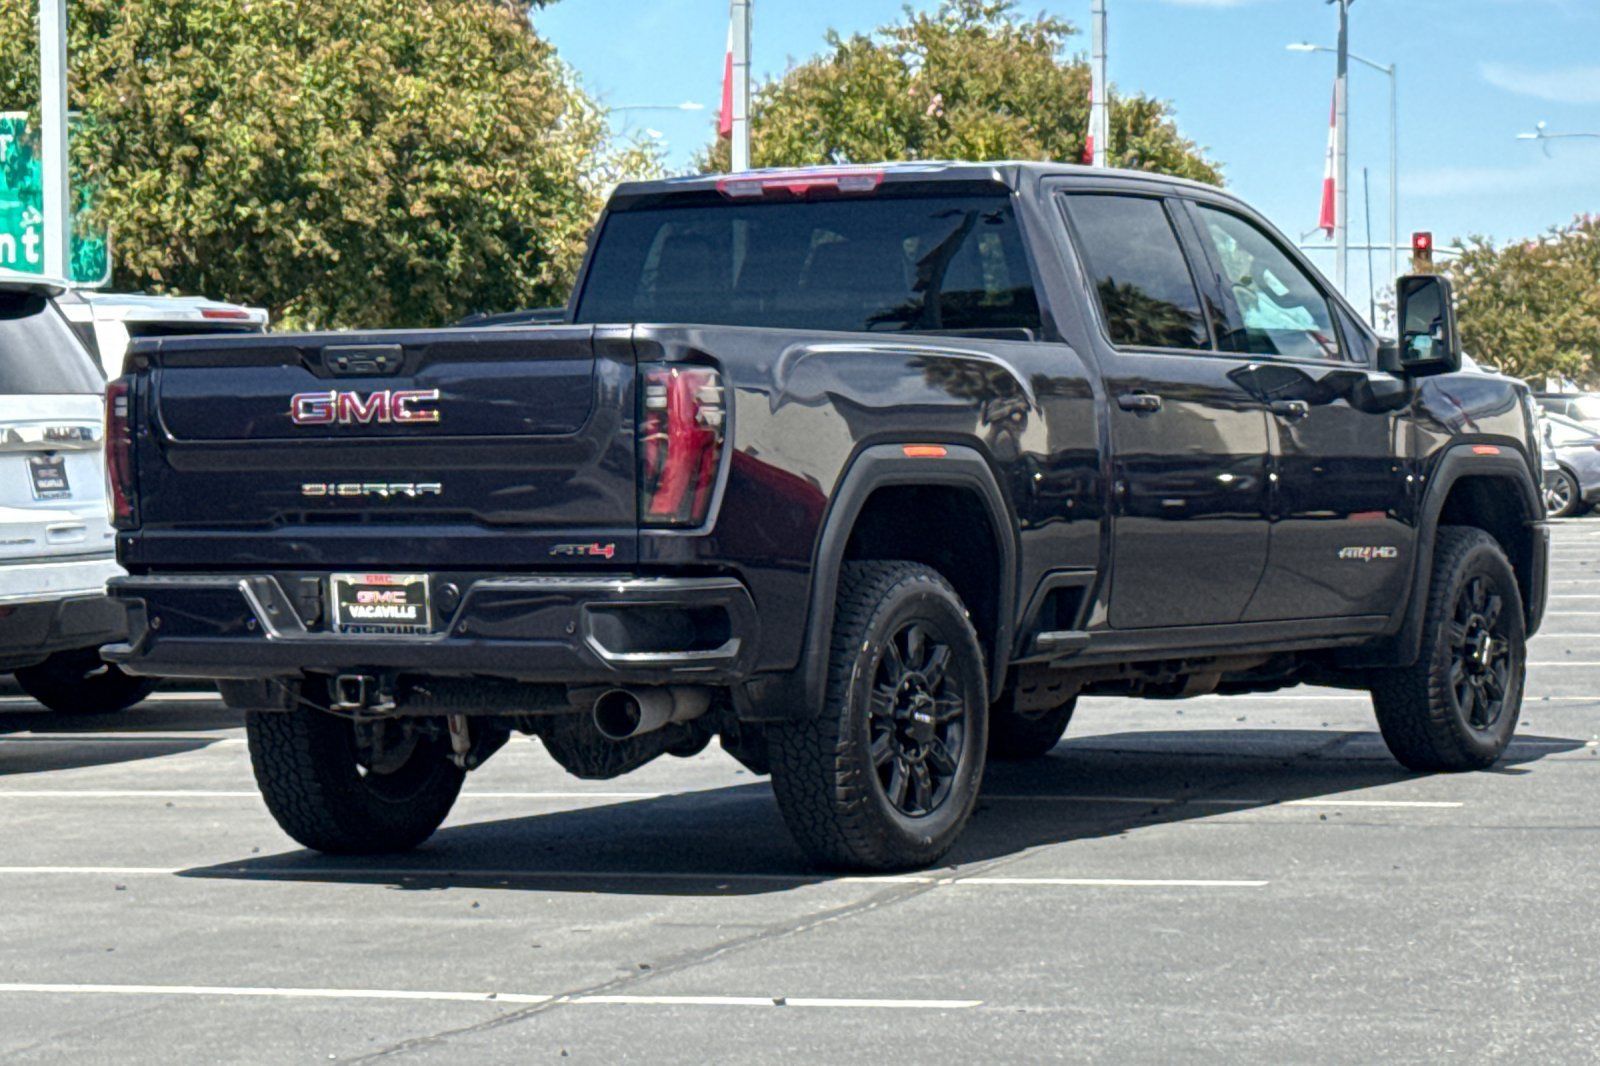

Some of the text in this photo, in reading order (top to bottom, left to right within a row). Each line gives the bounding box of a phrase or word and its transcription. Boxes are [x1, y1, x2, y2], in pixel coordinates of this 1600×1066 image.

[291, 389, 440, 424] GMC
[302, 483, 442, 496] SIERRA
[549, 543, 615, 559] AT4
[366, 575, 392, 583] GMC
[357, 591, 407, 603] GMC
[349, 605, 417, 618] VACAVILLE
